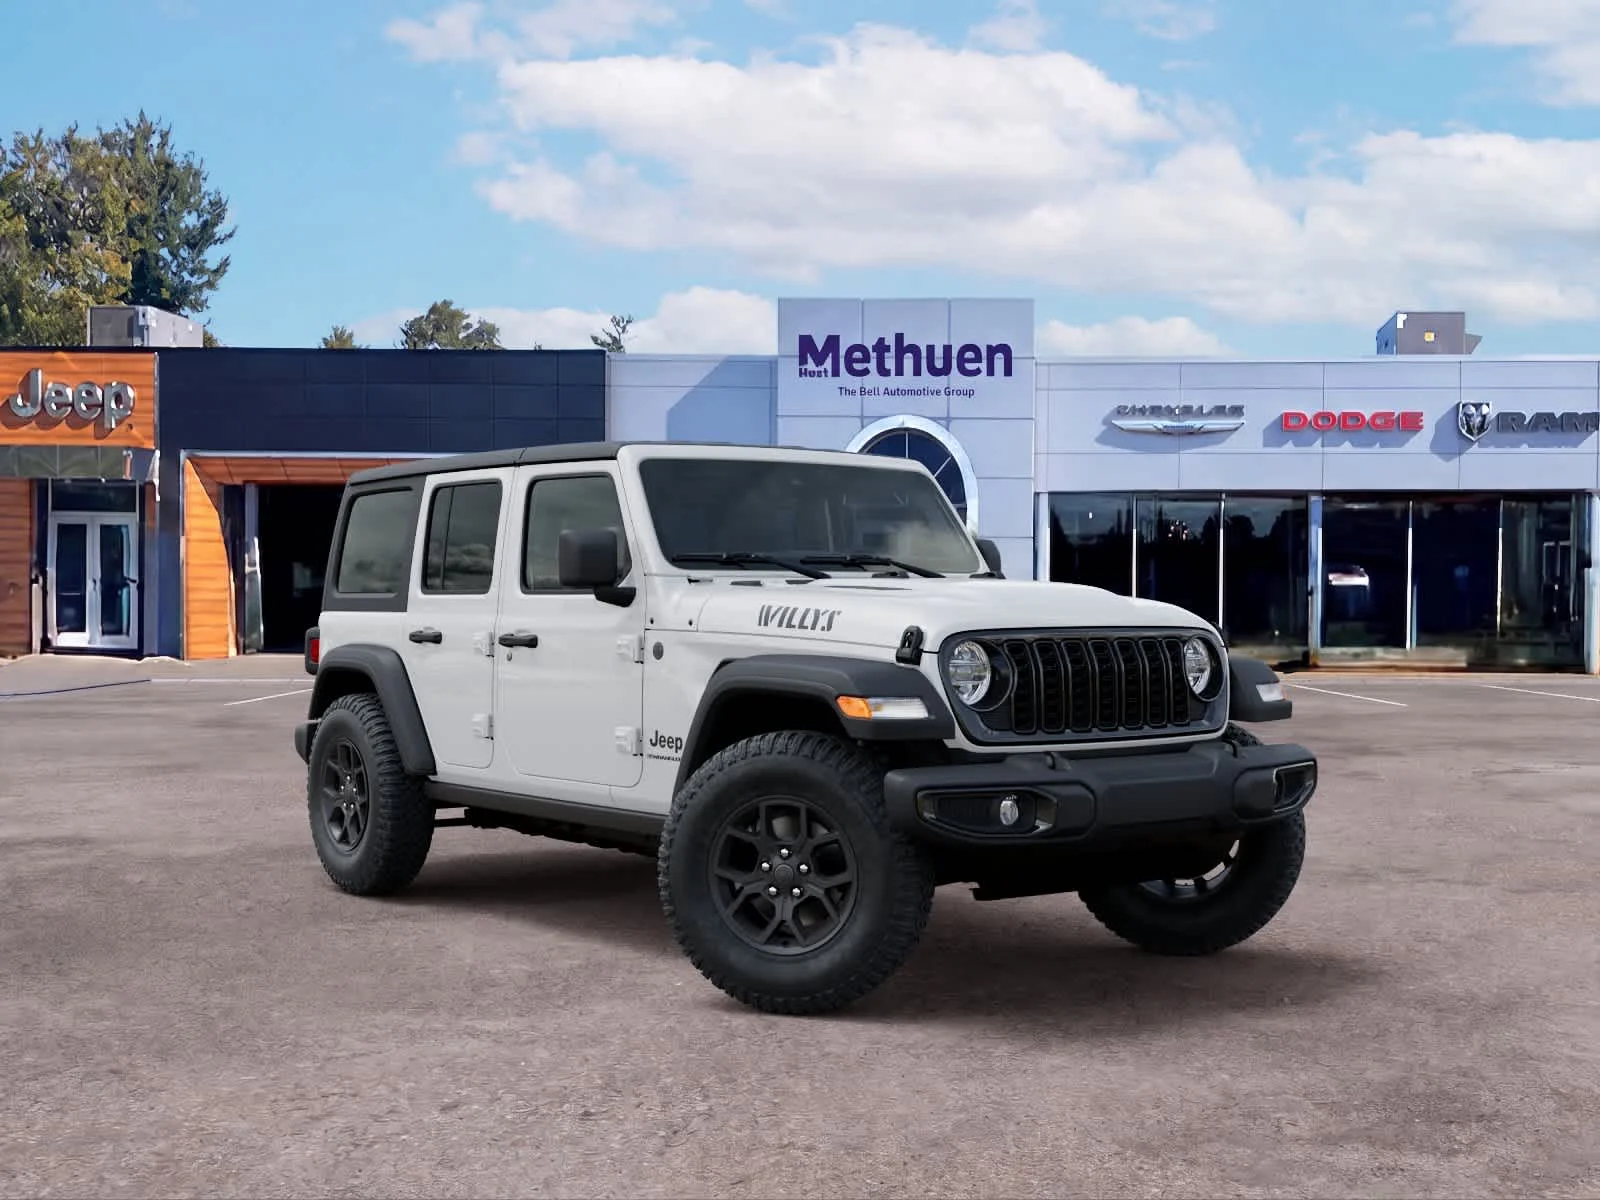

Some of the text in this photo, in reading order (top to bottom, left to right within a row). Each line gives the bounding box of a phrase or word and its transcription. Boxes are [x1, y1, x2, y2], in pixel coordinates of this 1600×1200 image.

[798, 333, 1013, 378] Methuen
[9, 368, 136, 430] Jeep
[838, 386, 975, 399] The Bell Automotive Group
[1282, 410, 1424, 432] DODGE
[1497, 411, 1600, 433] RAM
[758, 604, 842, 632] WILLYS
[650, 730, 683, 753] Jeep
